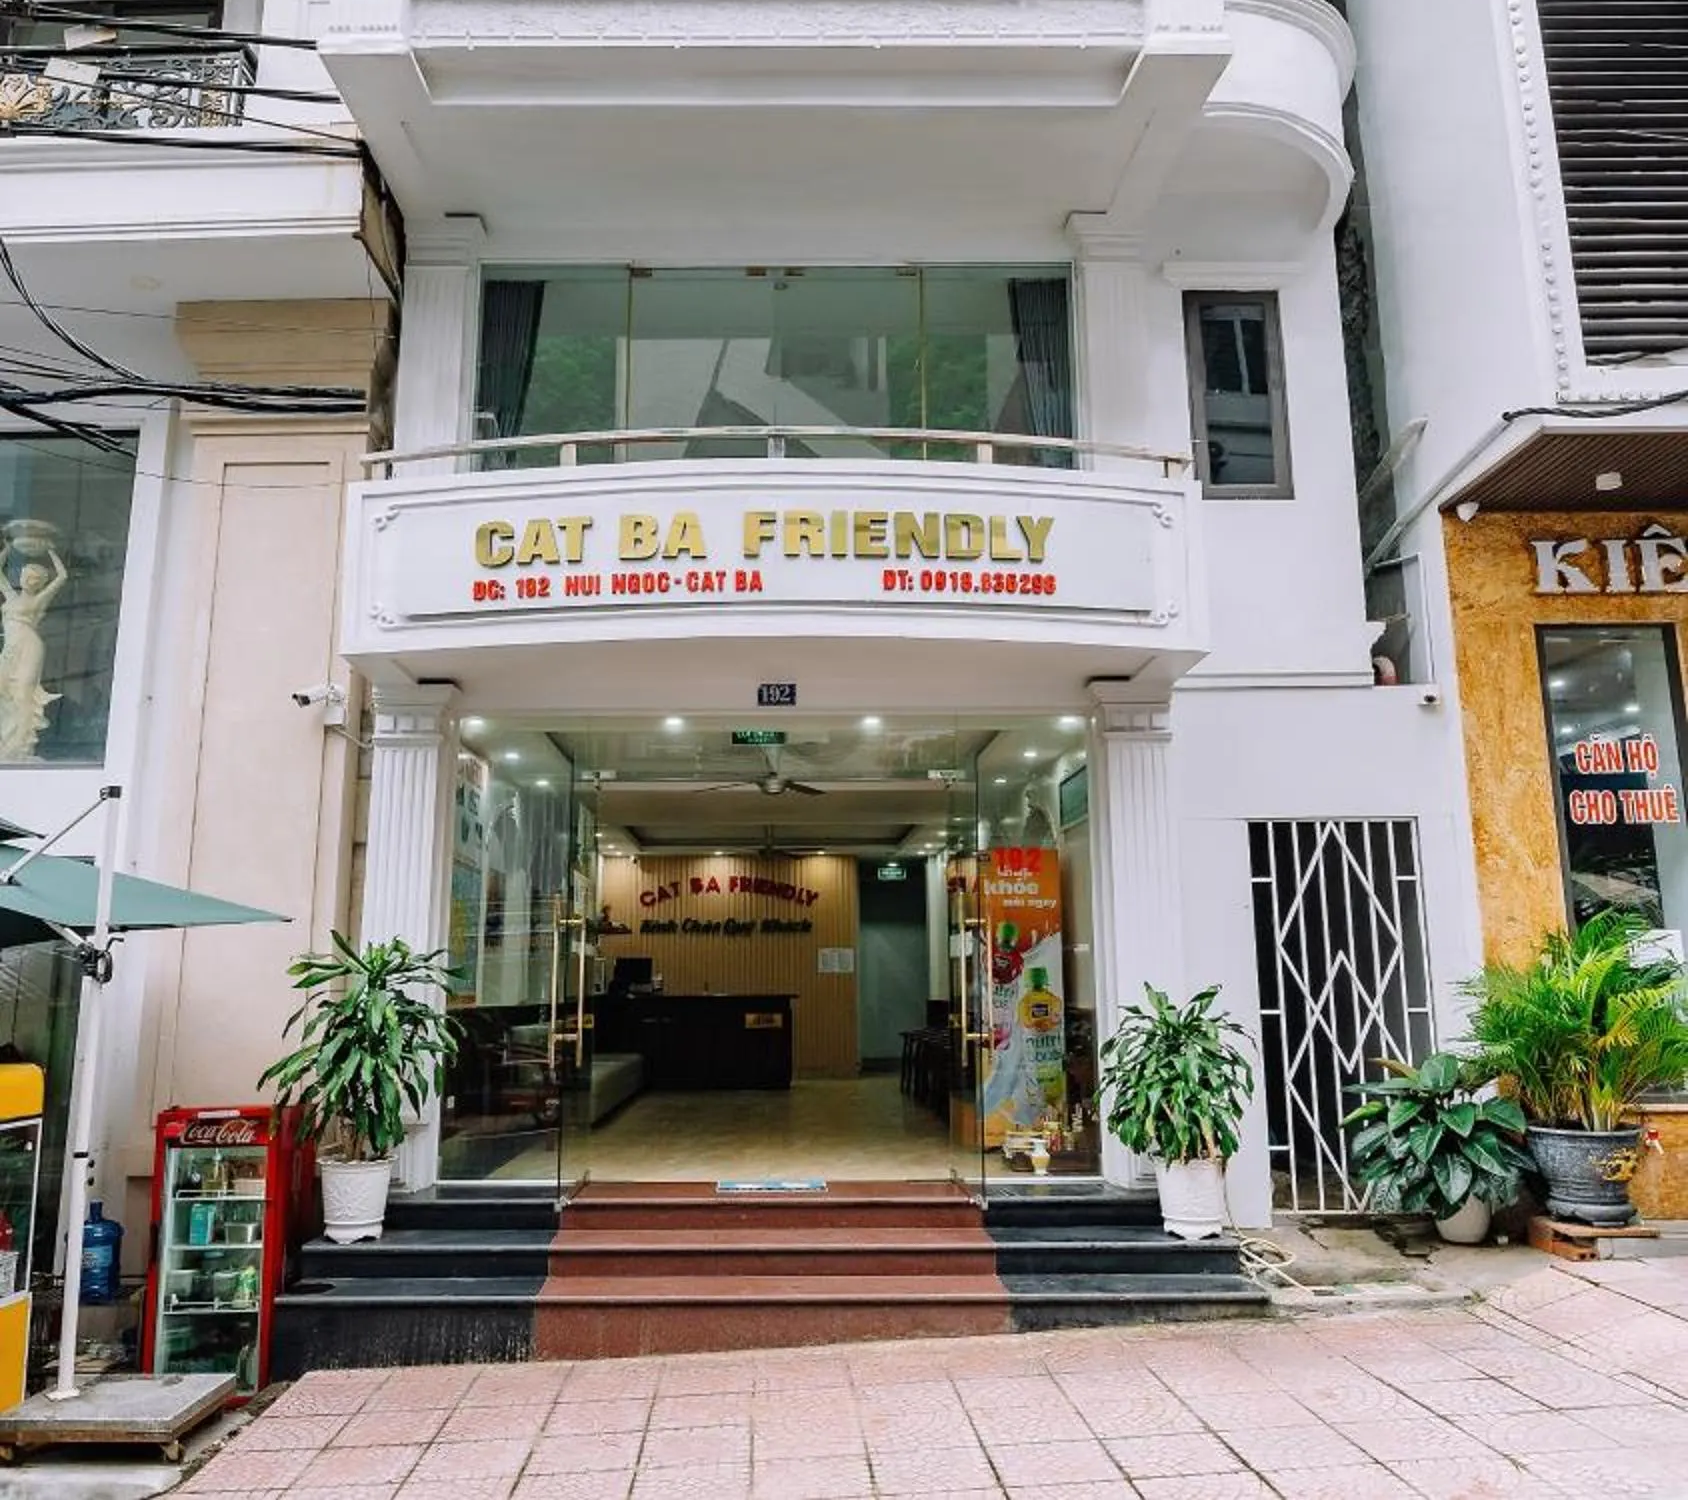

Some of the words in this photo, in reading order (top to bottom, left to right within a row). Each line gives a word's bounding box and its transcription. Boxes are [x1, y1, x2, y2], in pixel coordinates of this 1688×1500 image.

[475, 516, 593, 568] CAT
[619, 512, 707, 561] BA
[743, 510, 1055, 563] FRIENDLY
[515, 576, 550, 598] 192
[735, 570, 763, 593] BA
[760, 685, 792, 703] 192
[1576, 733, 1624, 774] CĂN
[1626, 733, 1659, 779] HỘ
[1570, 790, 1616, 824] CHO
[1618, 784, 1680, 824] THUÊ
[640, 881, 681, 906] CAT
[690, 876, 720, 895] BA
[728, 876, 819, 906] FRIENDLY
